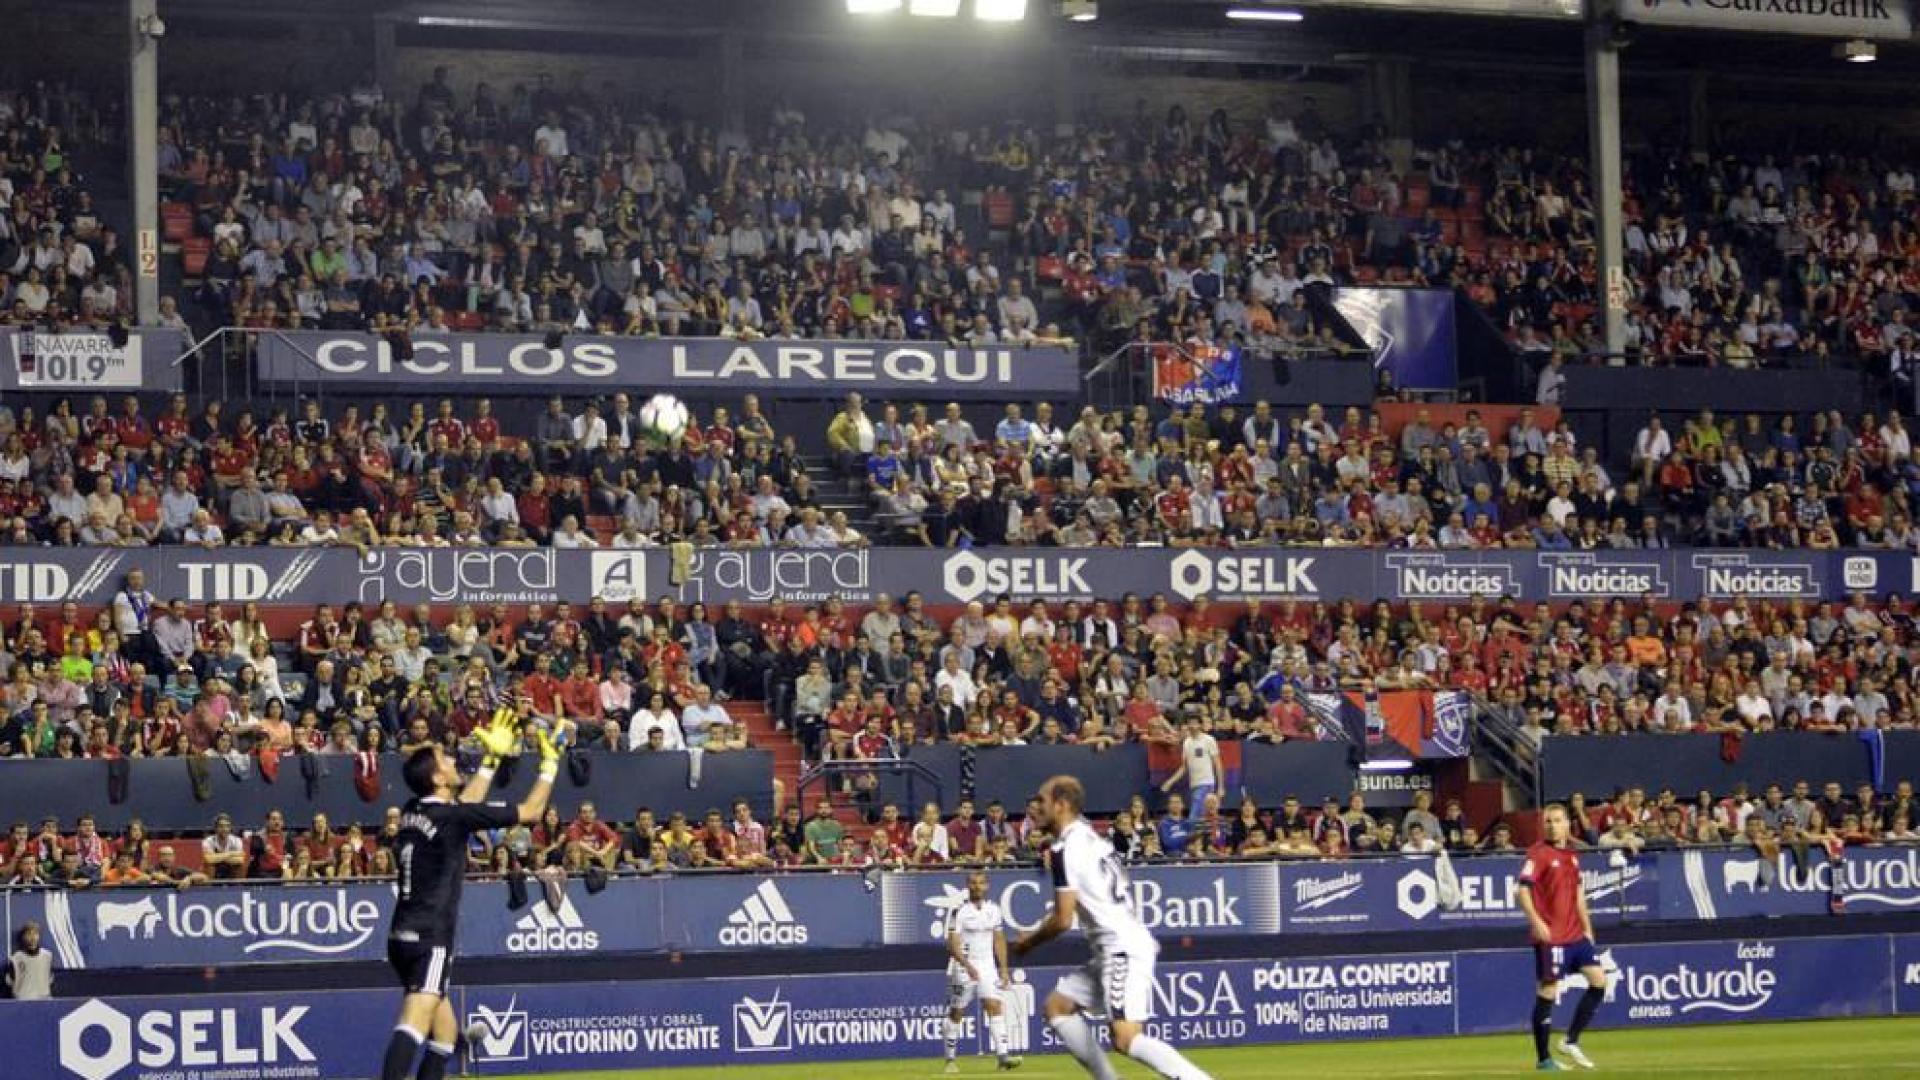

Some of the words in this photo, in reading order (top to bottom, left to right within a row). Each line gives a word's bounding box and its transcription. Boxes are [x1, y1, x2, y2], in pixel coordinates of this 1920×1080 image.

[36, 337, 125, 354] NAVARR
[315, 339, 617, 377] CICLOS
[672, 346, 1012, 383] LAREQUI
[178, 563, 270, 602] TID
[395, 547, 557, 602] ayerdi
[715, 549, 870, 602] ayerdi
[985, 557, 1092, 595] SELK
[1217, 557, 1319, 594] SELK
[1404, 567, 1503, 593] Noticias
[1555, 566, 1651, 593] Noticias
[1709, 568, 1803, 593] Noticias
[168, 889, 379, 938] lacturale
[1000, 877, 1242, 931] CBank
[507, 924, 600, 951] adidas
[719, 918, 808, 946] adidas
[1253, 962, 1337, 991] PÓLIZA
[1341, 961, 1450, 987] CONFORT
[1628, 964, 1776, 1000] lacturale
[1303, 990, 1357, 1011] Clínica
[1361, 985, 1452, 1009] Universidad
[530, 1015, 646, 1030] CONSTRUCCIONES
[650, 1015, 660, 1027] Y
[662, 1014, 704, 1027] OBRAS
[793, 1007, 904, 1021] CONSTRUCCIONES
[909, 1006, 918, 1018] Y
[1254, 1001, 1299, 1025] 100%
[1304, 1012, 1325, 1033] de
[1328, 1012, 1389, 1031] Navarra
[138, 1005, 317, 1068] SELK
[530, 1028, 639, 1055] VICTORINO
[646, 1025, 720, 1052] VICENTE
[793, 1021, 897, 1045] VICTORINO
[902, 1016, 977, 1041] VICETE
[1180, 1019, 1246, 1041] SALUD
